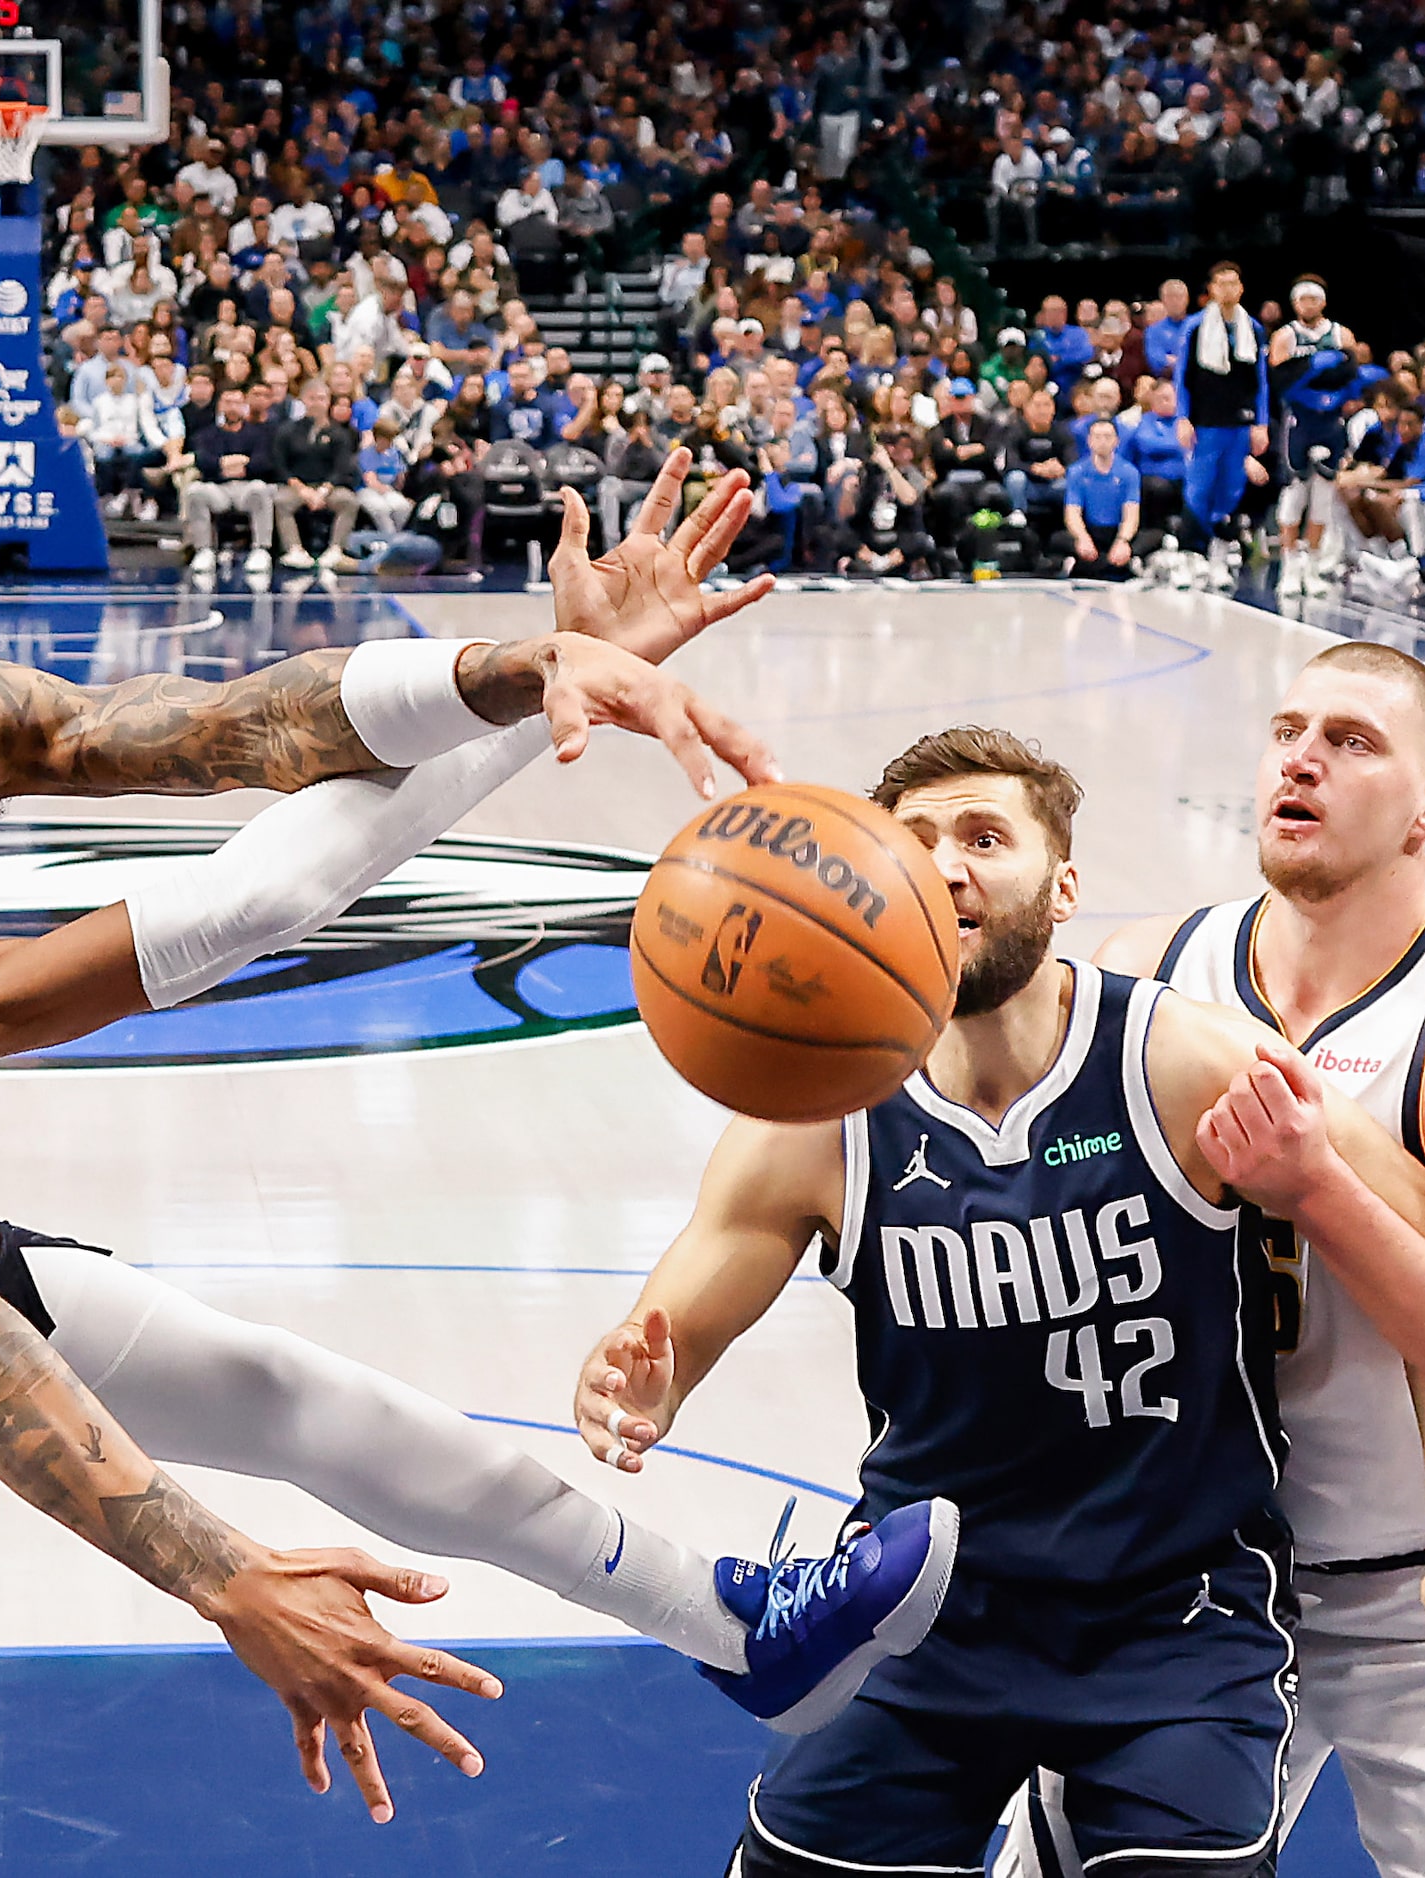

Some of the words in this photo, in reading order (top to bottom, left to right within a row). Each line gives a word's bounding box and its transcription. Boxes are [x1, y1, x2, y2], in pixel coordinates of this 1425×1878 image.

[696, 804, 888, 930] Wilson
[1314, 1047, 1382, 1073] ibotta
[1044, 1131, 1122, 1166] chime
[879, 1193, 1163, 1329] MAVS
[1044, 1317, 1179, 1428] 42
